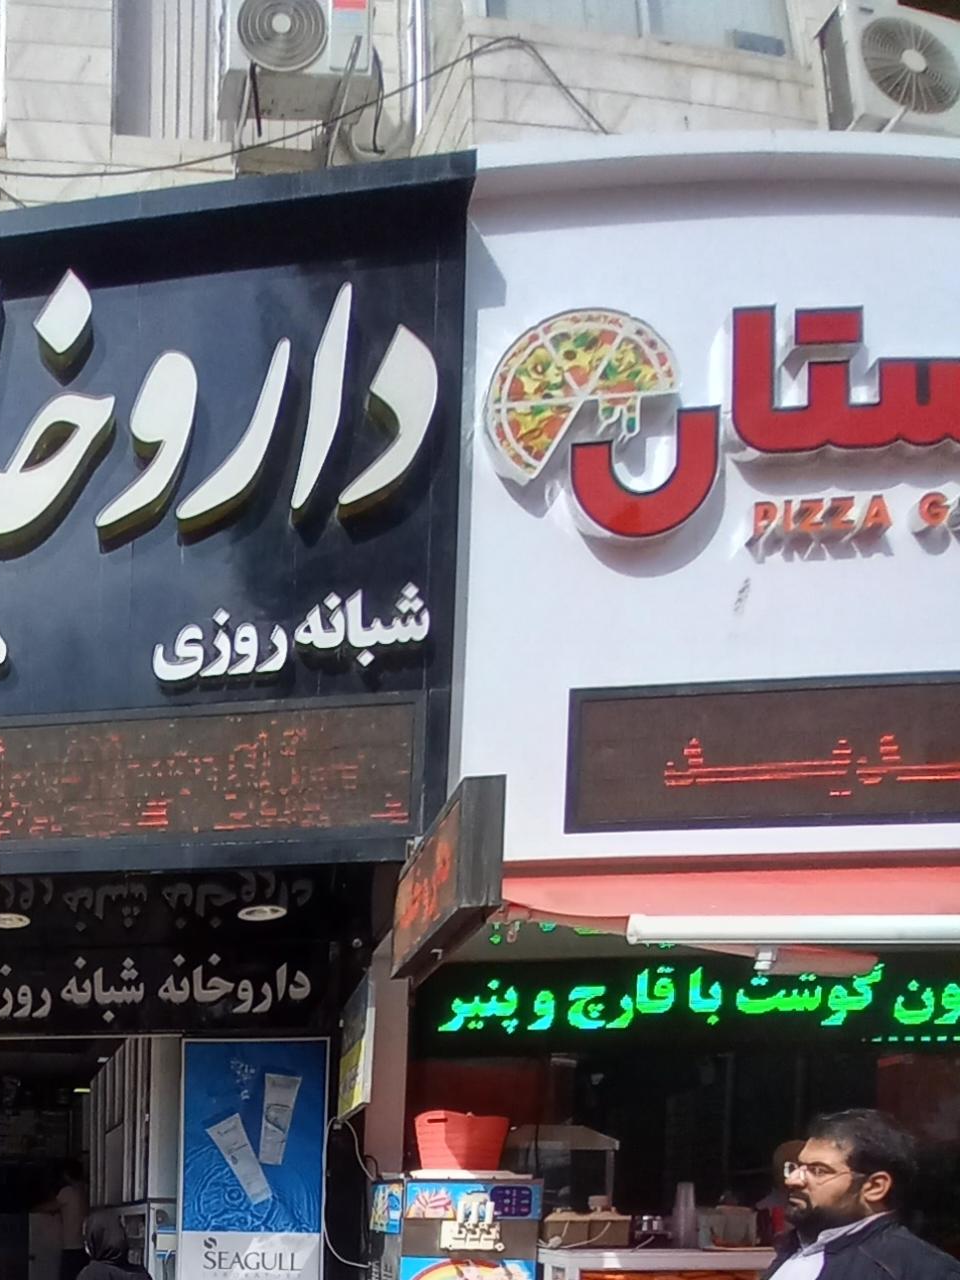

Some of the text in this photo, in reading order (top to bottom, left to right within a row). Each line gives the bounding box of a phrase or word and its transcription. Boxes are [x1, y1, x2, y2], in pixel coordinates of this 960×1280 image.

[570, 305, 960, 540] ستان
[754, 494, 892, 537] PIZZA
[151, 583, 430, 682] شبانه روزی
[60, 957, 144, 1022] شبانه
[157, 953, 311, 1014] داروخانه
[439, 964, 884, 1034] گوشت با قارچ و پنیر
[203, 1251, 303, 1271] SEAGULL
